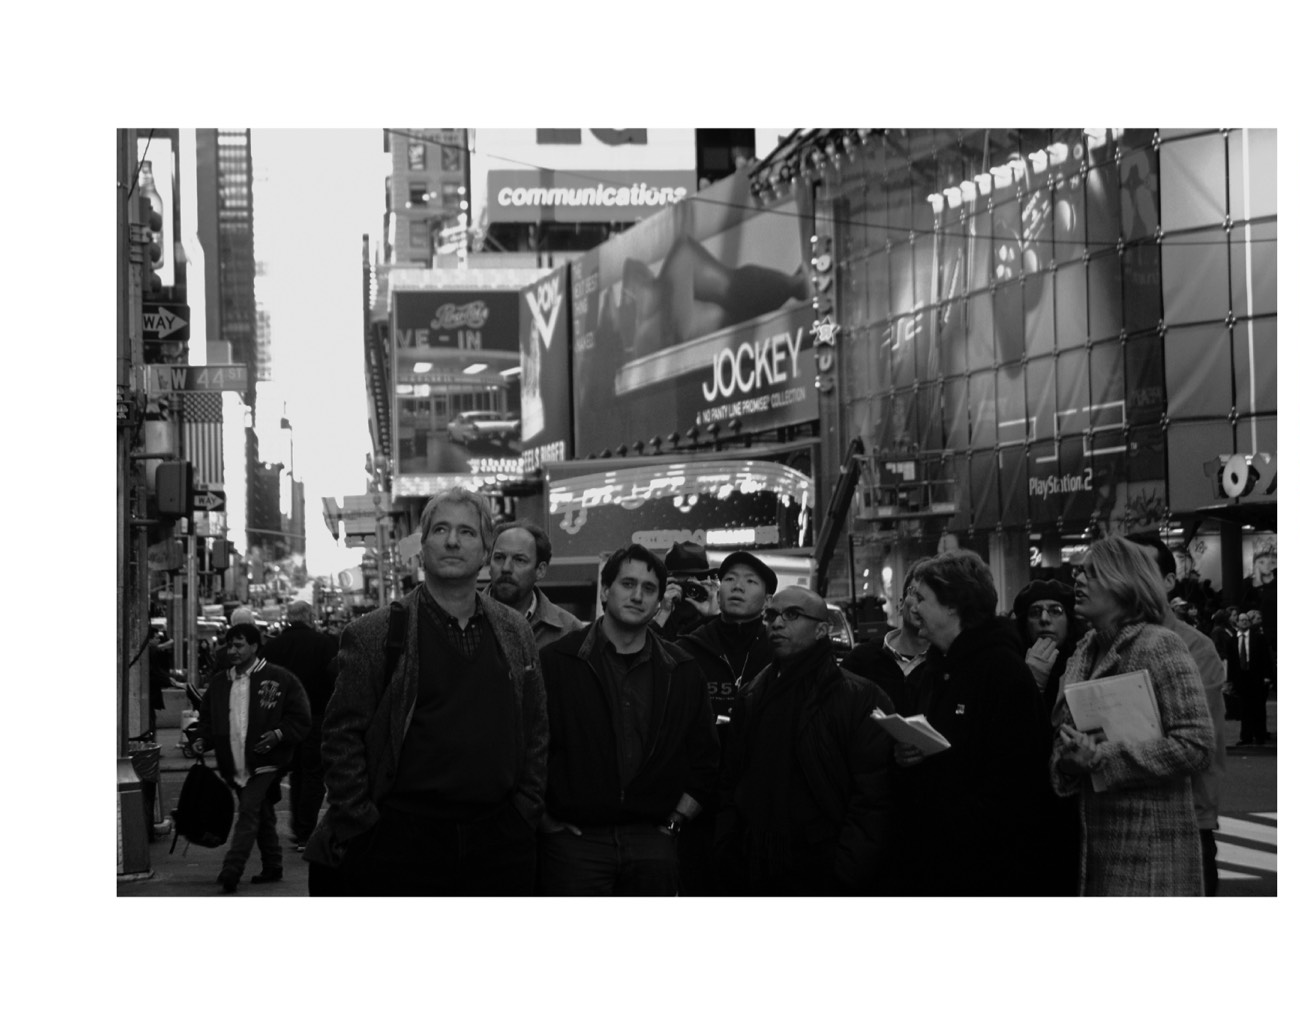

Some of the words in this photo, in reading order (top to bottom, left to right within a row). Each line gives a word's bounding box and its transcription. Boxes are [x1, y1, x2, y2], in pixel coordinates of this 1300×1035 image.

[498, 182, 687, 207] communications
[143, 315, 175, 330] WAY
[702, 327, 804, 402] JOCKEY
[172, 368, 187, 391] W
[196, 368, 224, 389] 44
[711, 405, 728, 421] PANTY
[728, 401, 742, 417] LINE
[770, 387, 806, 408] COLLECTION
